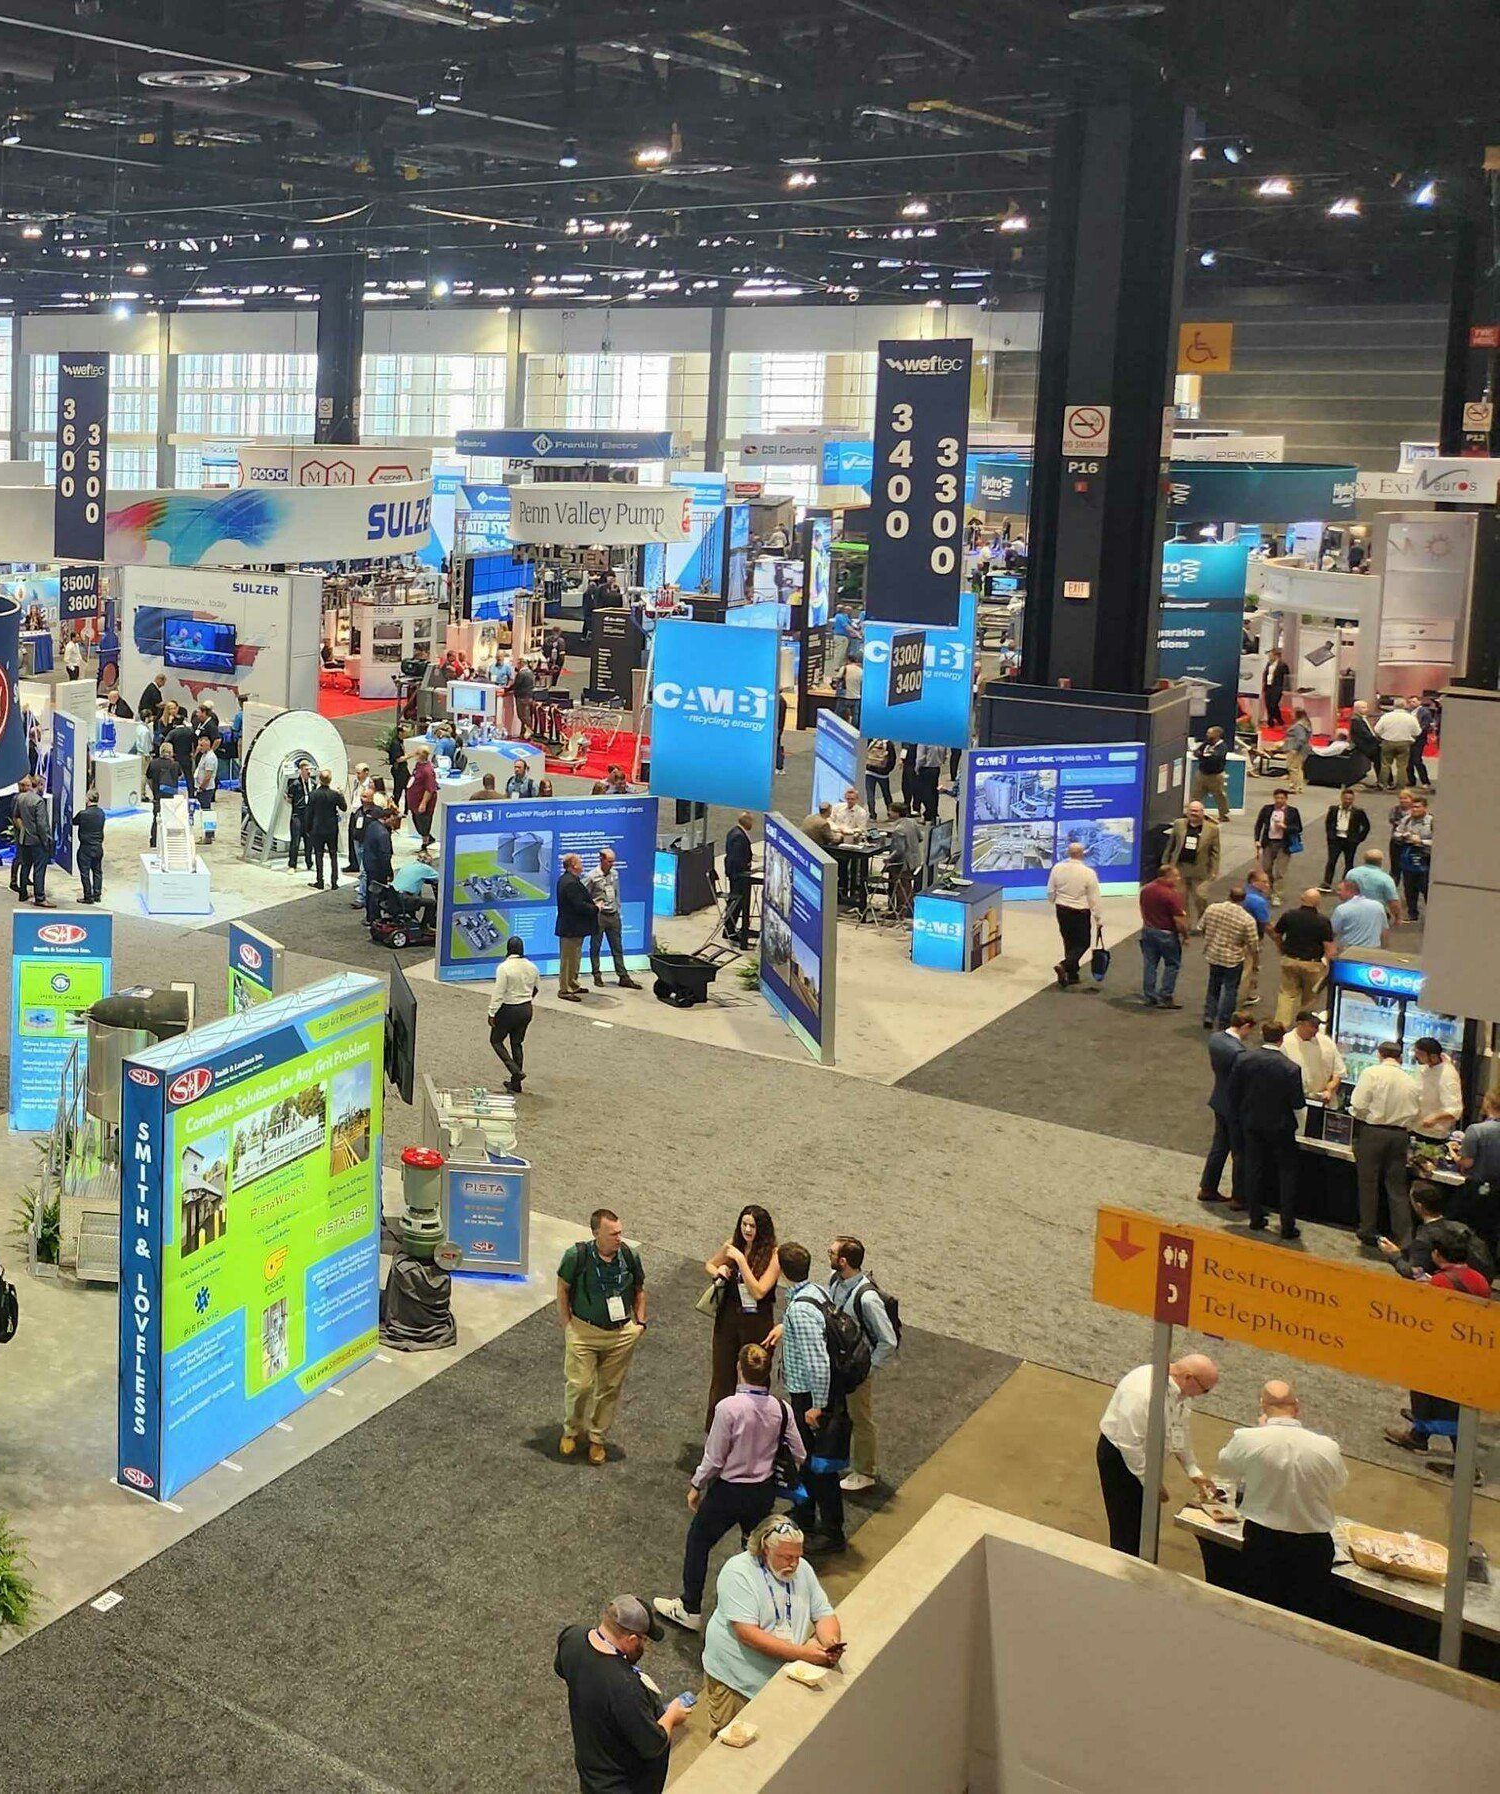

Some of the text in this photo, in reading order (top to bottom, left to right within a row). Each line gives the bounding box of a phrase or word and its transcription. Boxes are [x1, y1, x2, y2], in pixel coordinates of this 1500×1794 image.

[73, 364, 105, 376] weftec
[904, 355, 963, 371] weftec
[61, 398, 76, 498] 3600
[555, 441, 638, 450] Franklin Electric
[1217, 450, 1276, 460] PRIMEX
[85, 423, 101, 524] 3500
[509, 459, 534, 470] FPS
[886, 403, 914, 539] 3400
[1068, 462, 1098, 473] P16
[520, 501, 664, 532] Penn Valley Pump
[930, 438, 959, 575] 3300
[61, 574, 96, 591] 3500/
[232, 583, 279, 596] SULZER
[1068, 583, 1085, 595] EXIT
[68, 596, 97, 611] 3600
[893, 633, 924, 667] 3300/
[896, 669, 922, 695] 3400
[732, 719, 765, 731] energy
[170, 1068, 210, 1103] S&L
[185, 1105, 233, 1134] Complete
[235, 1084, 278, 1111] Solutions
[279, 1077, 293, 1091] for
[294, 1066, 312, 1086] Any
[333, 1040, 370, 1066] Problem
[465, 1183, 505, 1193] PISTA
[133, 1122, 151, 1435] SMITH & LOVELESS
[1202, 1257, 1496, 1349] Restrooms Shoe Shi
[1199, 1294, 1346, 1349] Telephones
